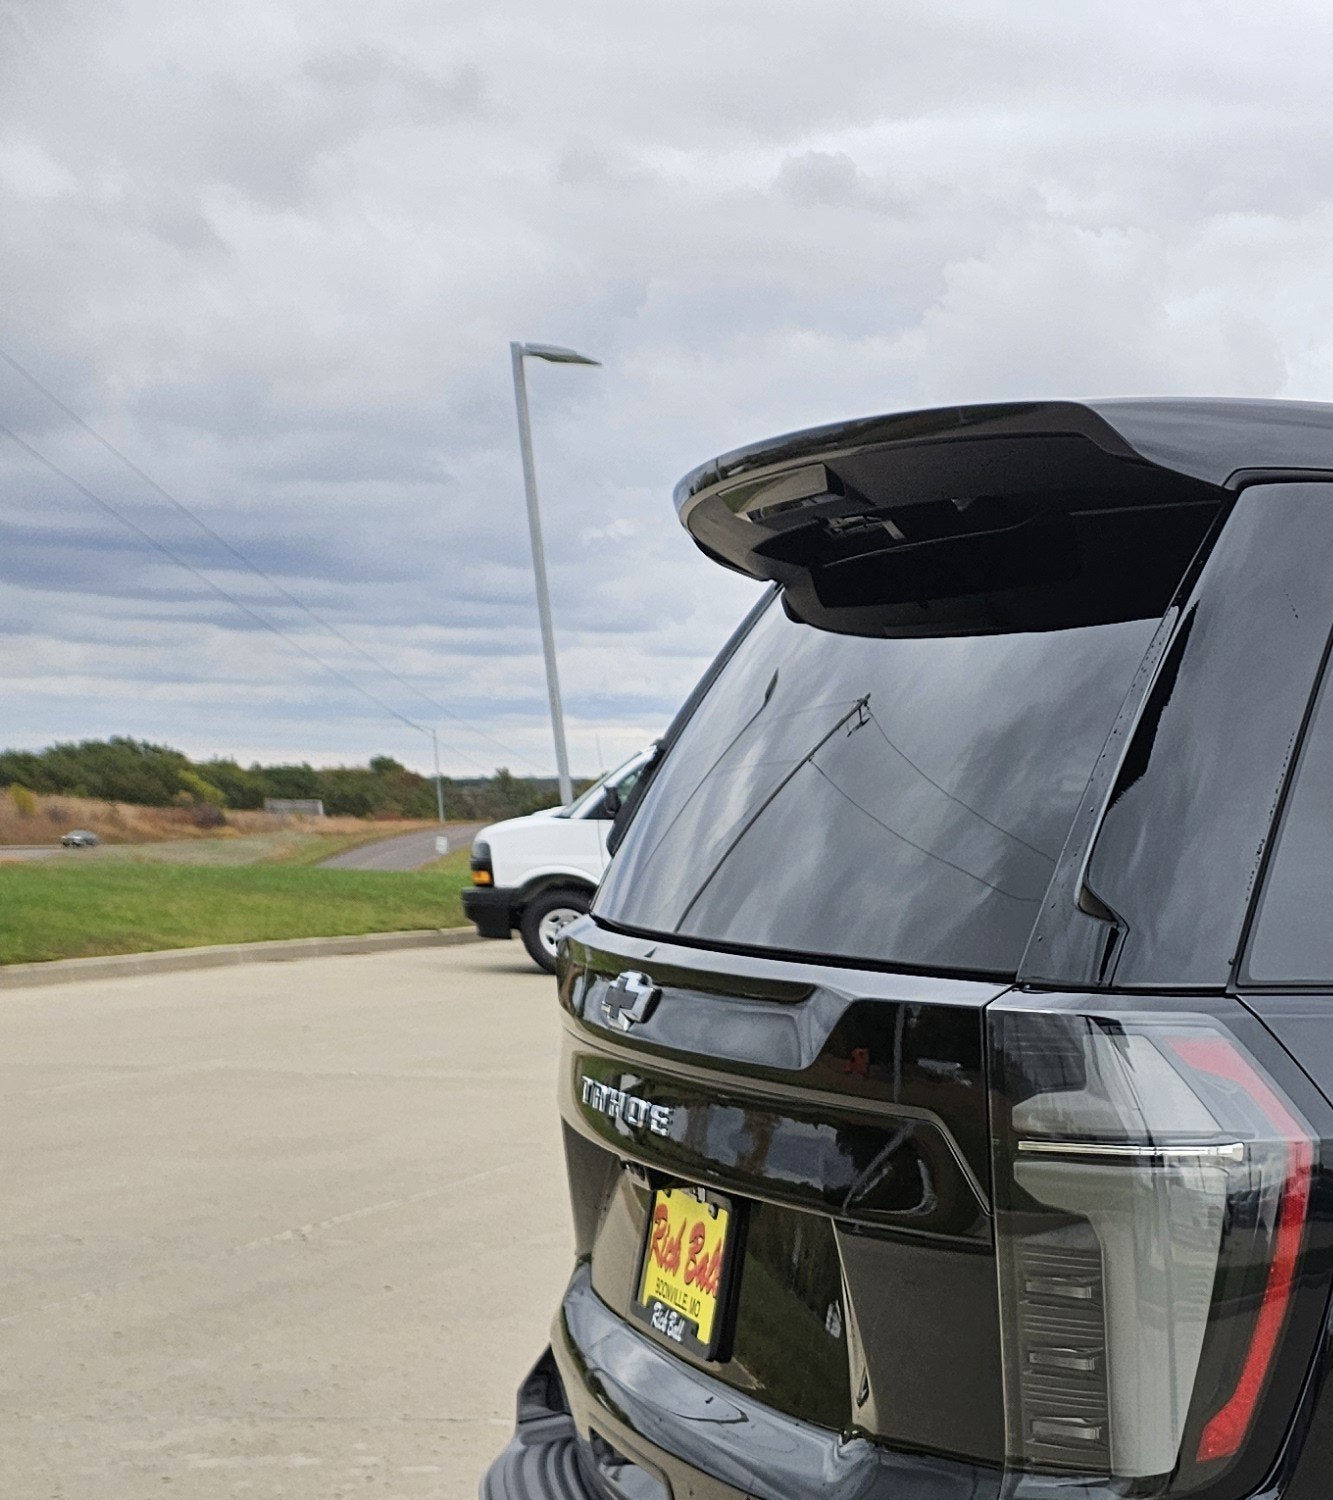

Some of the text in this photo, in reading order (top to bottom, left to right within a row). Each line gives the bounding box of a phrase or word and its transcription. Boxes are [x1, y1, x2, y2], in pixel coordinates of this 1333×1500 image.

[582, 1075, 674, 1136] TAHOE
[652, 1203, 688, 1278] Rick
[689, 1297, 701, 1318] MO
